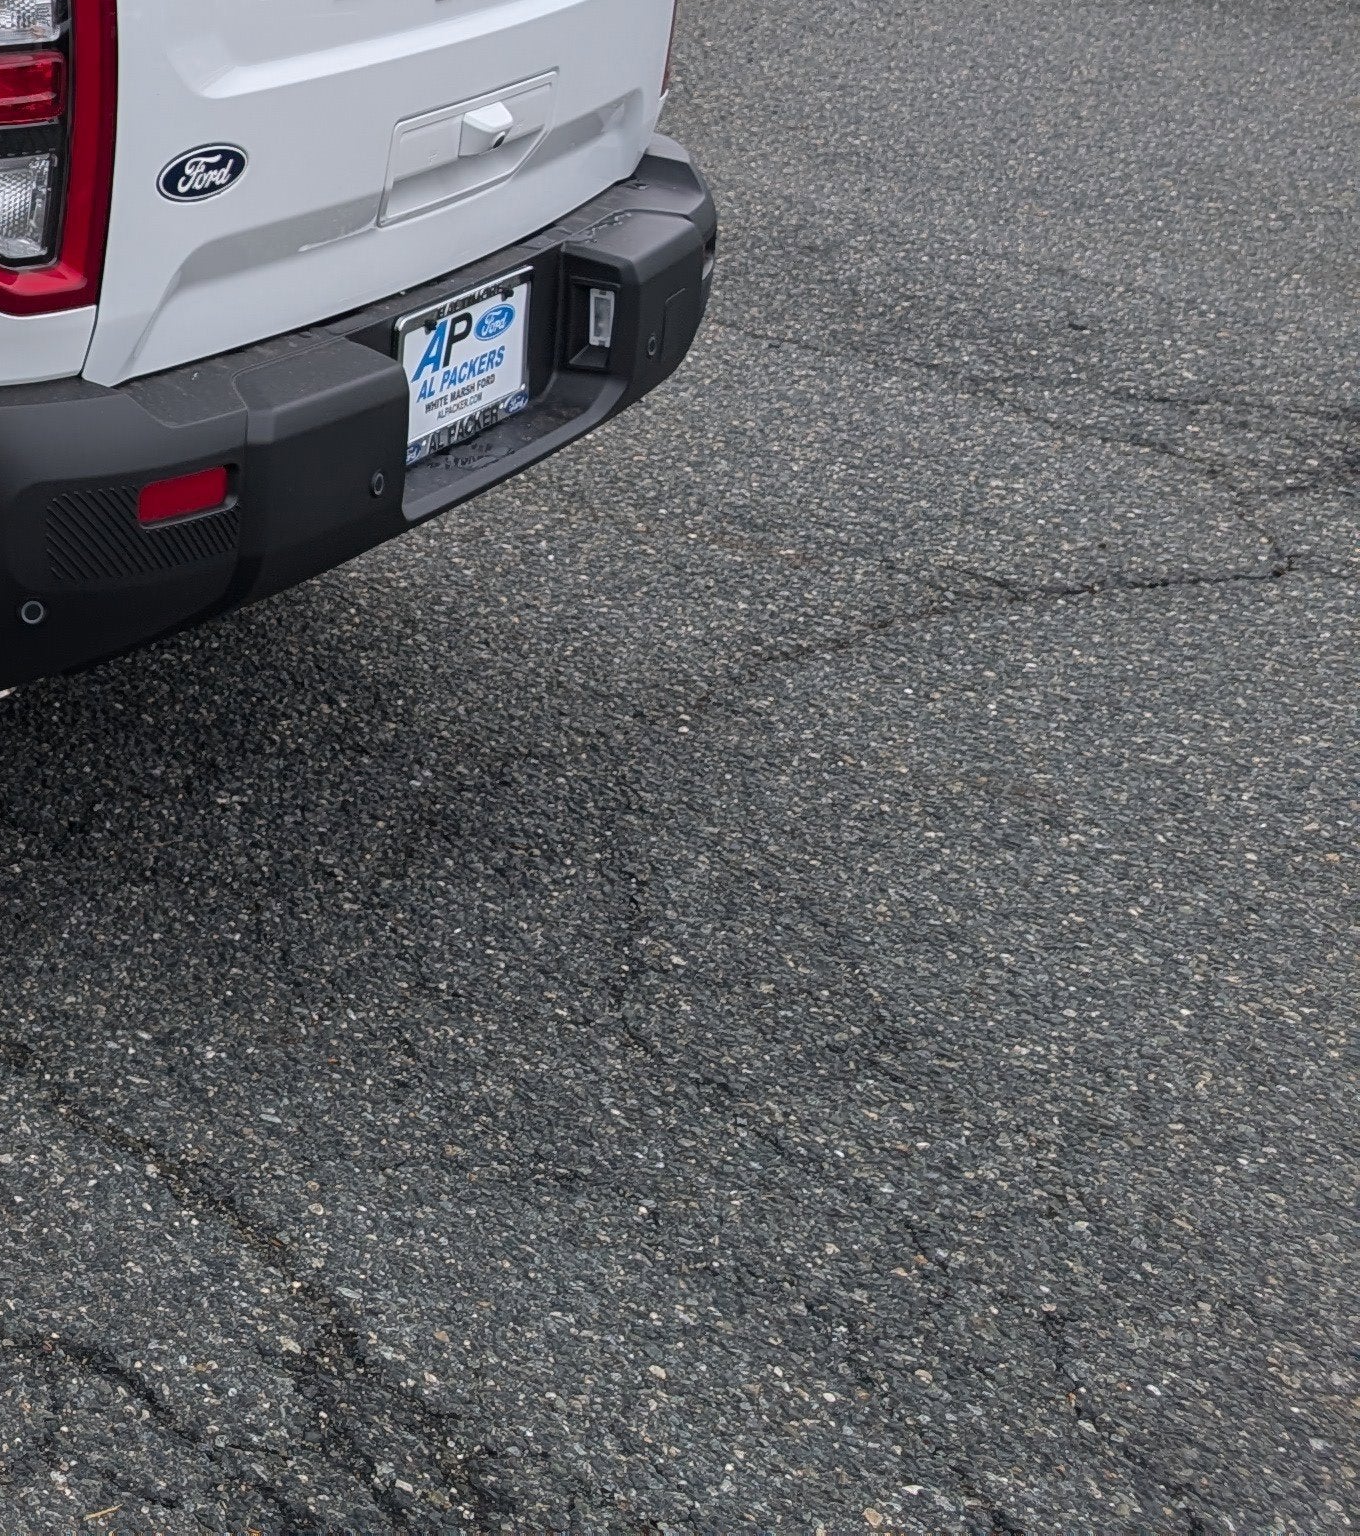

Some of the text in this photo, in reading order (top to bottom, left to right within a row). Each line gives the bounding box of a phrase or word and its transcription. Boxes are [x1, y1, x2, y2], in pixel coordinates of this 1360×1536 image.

[177, 154, 234, 193] Ford
[411, 312, 473, 383] AP
[416, 345, 506, 404] AL PACKERS
[425, 373, 496, 414] WHITE MARSH FORD
[447, 403, 499, 445] PACKER
